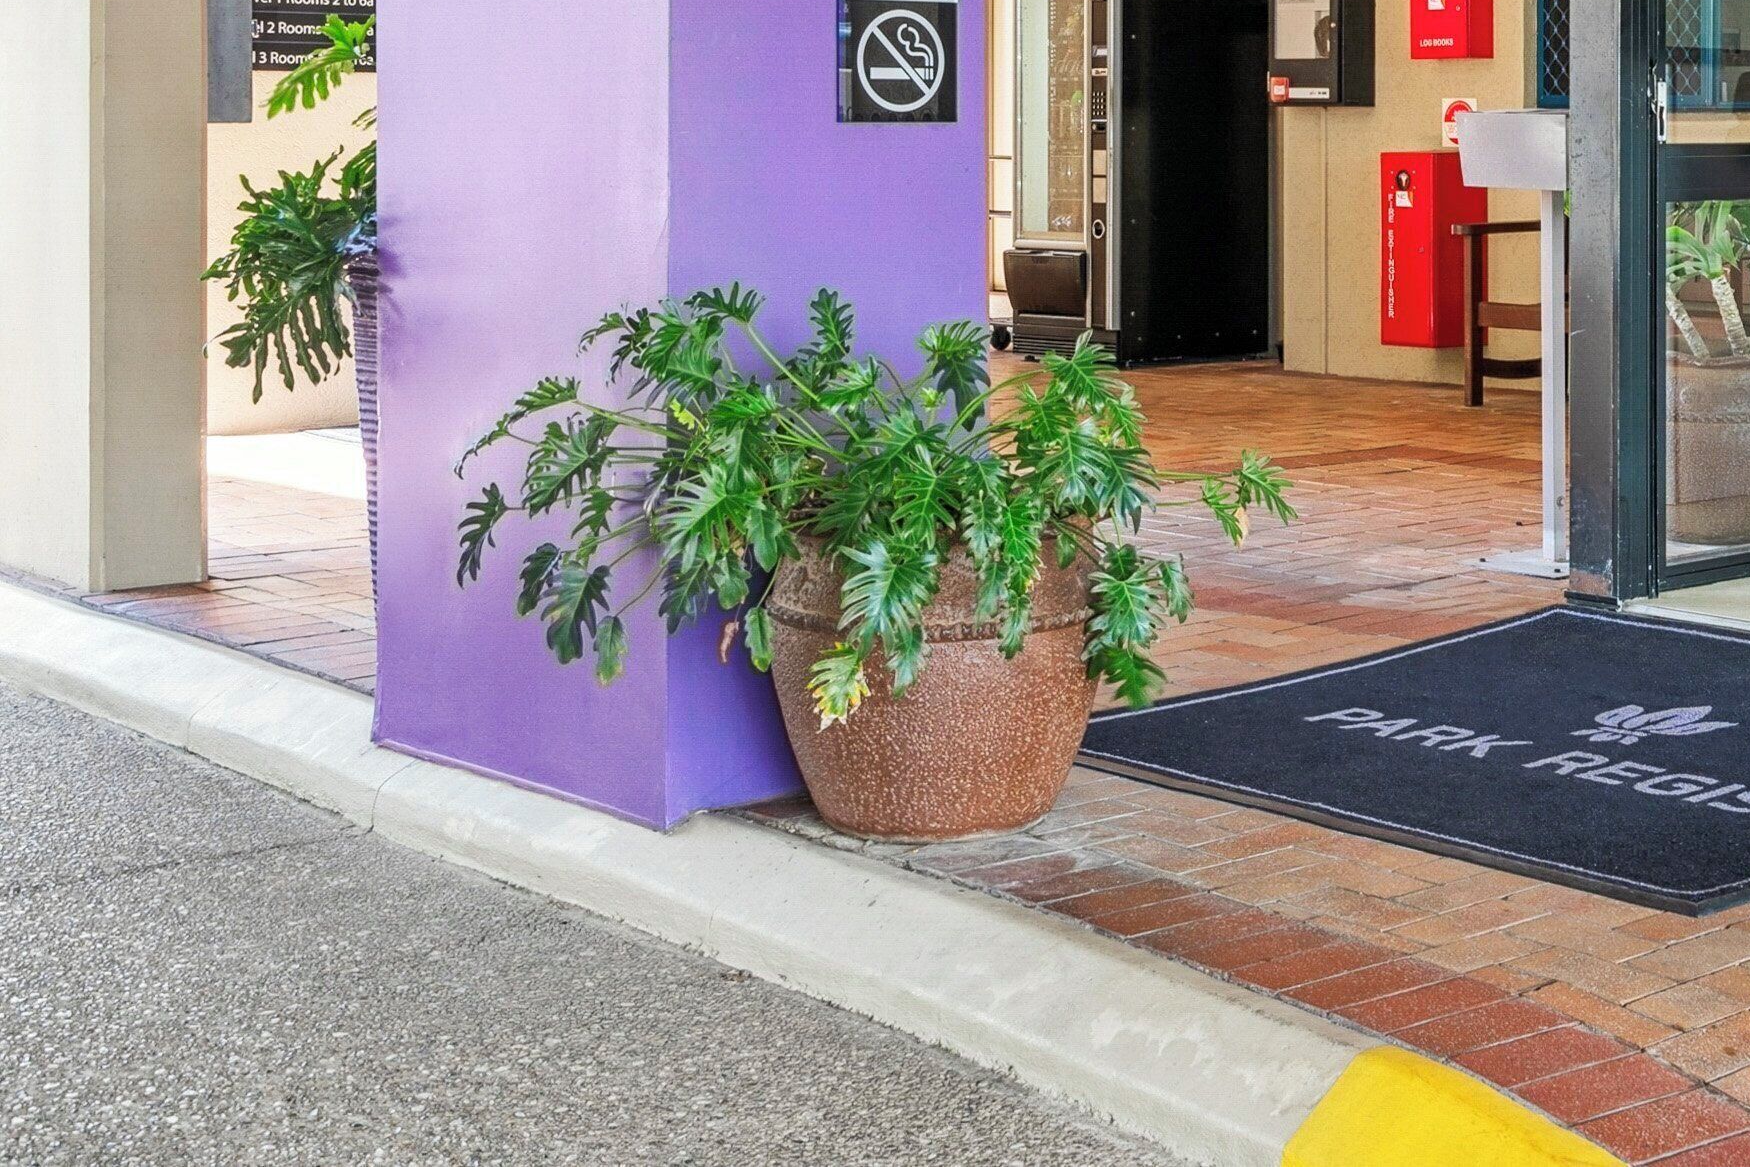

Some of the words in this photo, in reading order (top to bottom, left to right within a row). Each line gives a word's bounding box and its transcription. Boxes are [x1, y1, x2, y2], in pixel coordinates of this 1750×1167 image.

[267, 21, 275, 34] 2
[1420, 38, 1432, 47] LOG
[1433, 37, 1454, 47] BOOKS
[259, 51, 267, 64] 3
[1303, 706, 1535, 759] PARK
